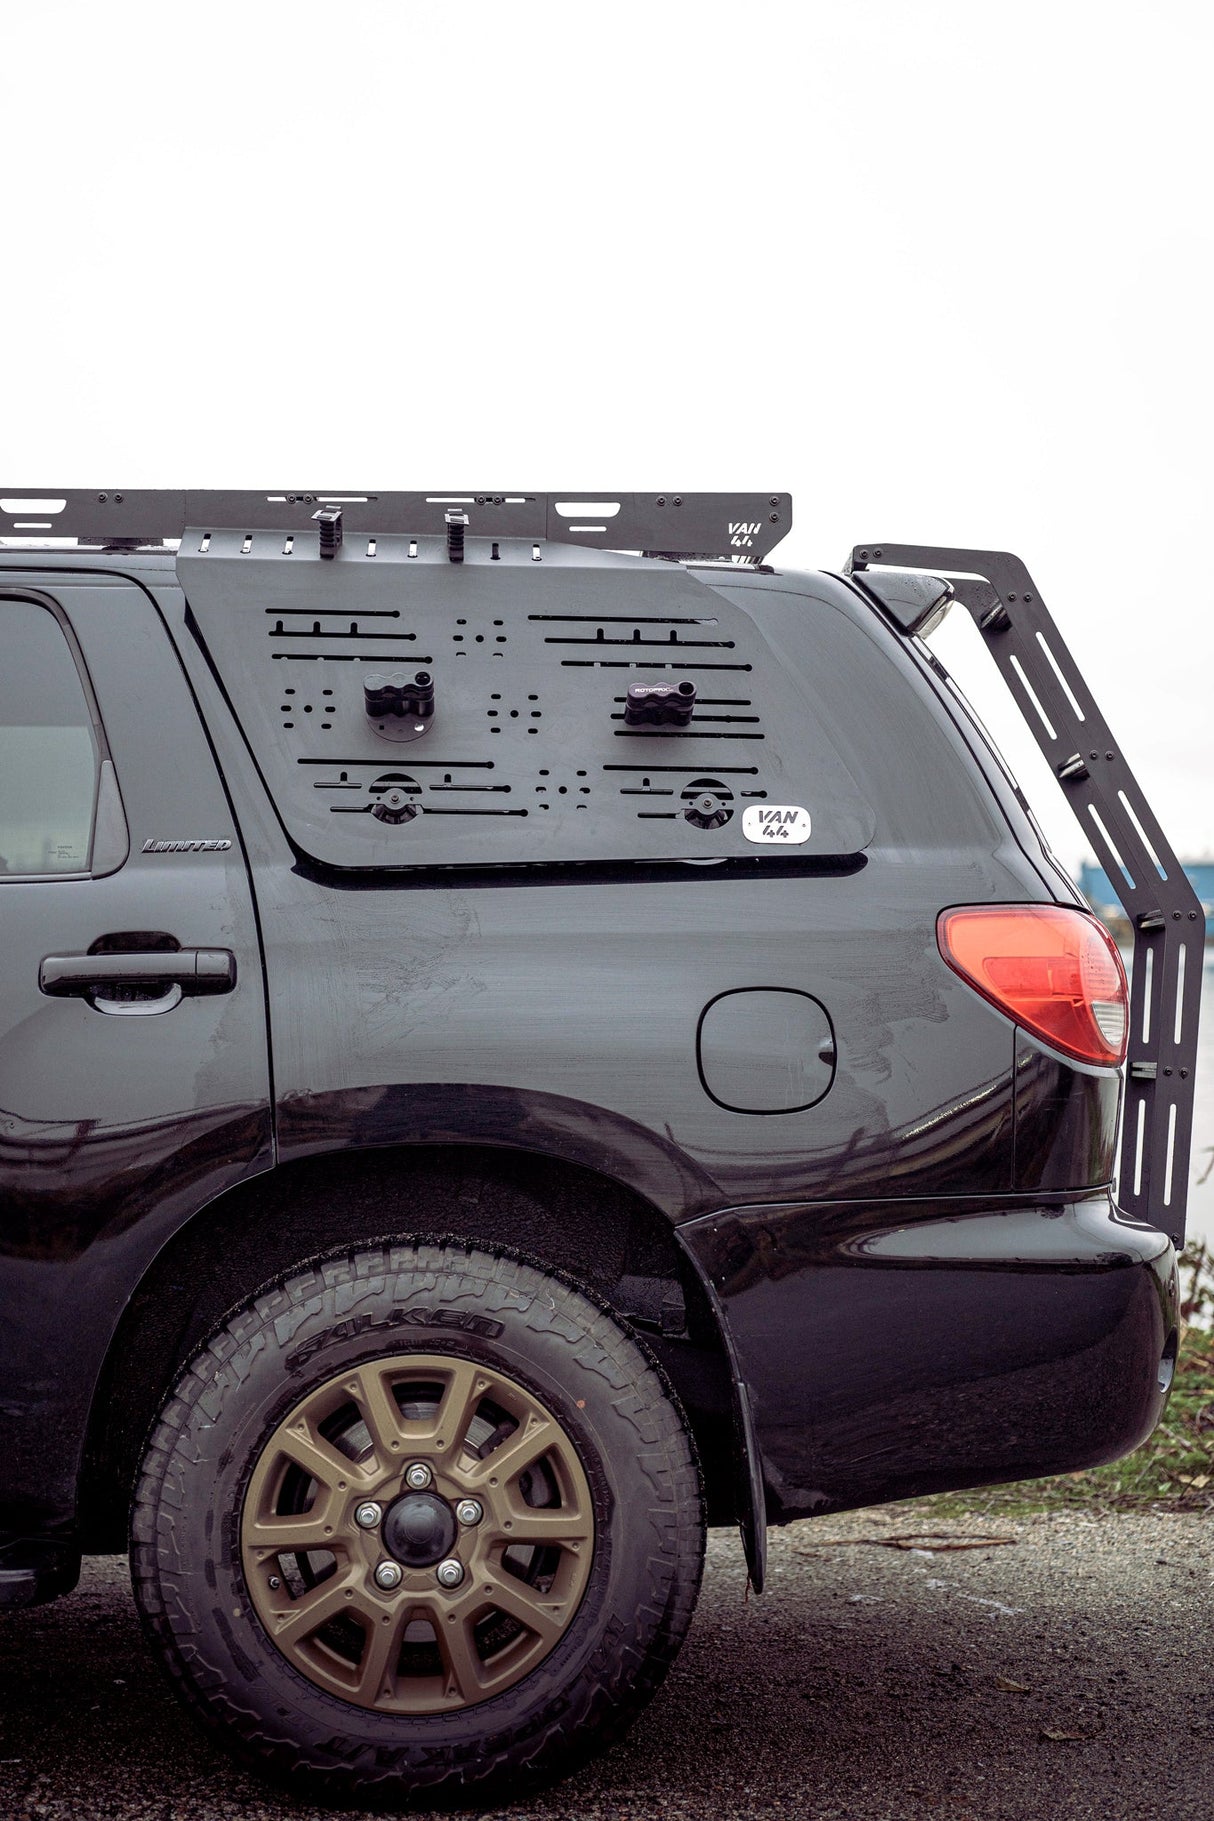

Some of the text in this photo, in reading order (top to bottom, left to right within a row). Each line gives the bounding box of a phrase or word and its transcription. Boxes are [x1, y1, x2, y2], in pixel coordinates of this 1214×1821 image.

[728, 522, 762, 534] VAN
[730, 535, 753, 547] 44
[758, 810, 799, 824] VAN
[762, 825, 790, 838] 44
[285, 1306, 506, 1371] FALKEN
